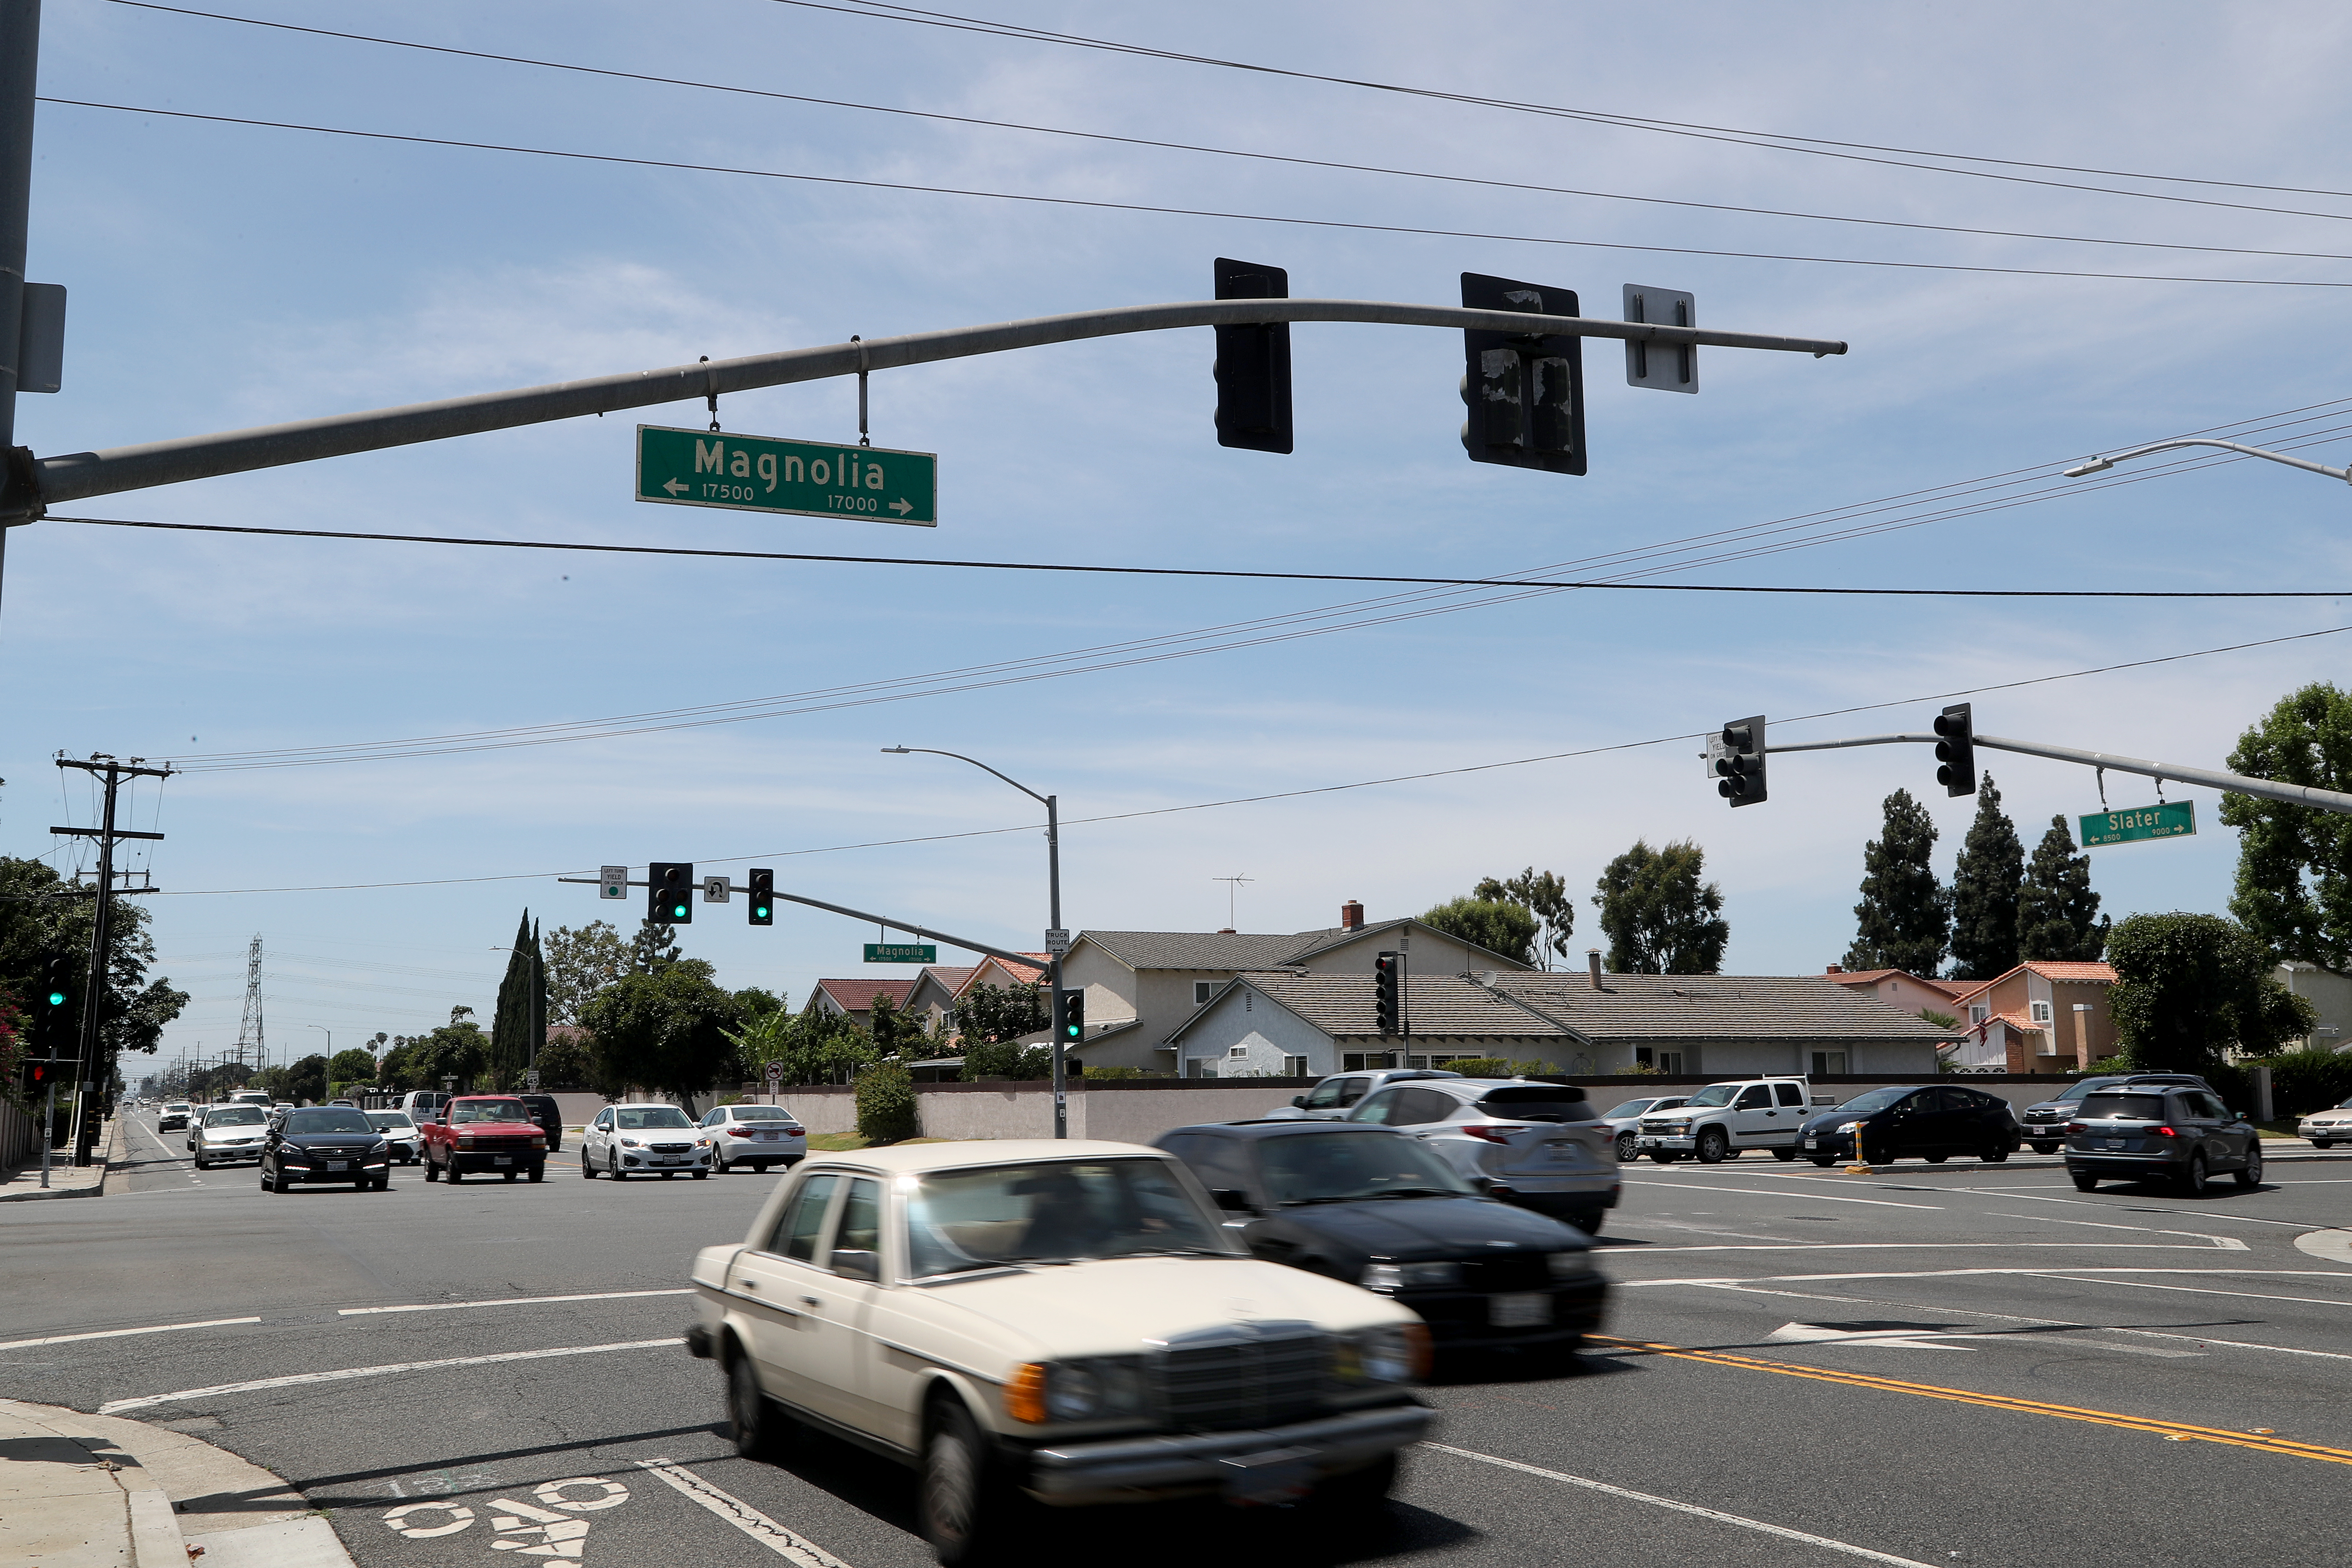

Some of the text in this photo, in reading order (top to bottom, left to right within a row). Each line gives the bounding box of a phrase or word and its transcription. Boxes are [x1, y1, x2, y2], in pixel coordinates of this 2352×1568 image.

[695, 439, 884, 493] Magnolia
[702, 483, 754, 501] 17500
[828, 495, 877, 512] 17000
[2109, 811, 2160, 831] Slater
[2103, 834, 2120, 842] 8500
[2152, 827, 2170, 835] 9000
[877, 946, 923, 958] Magnolia
